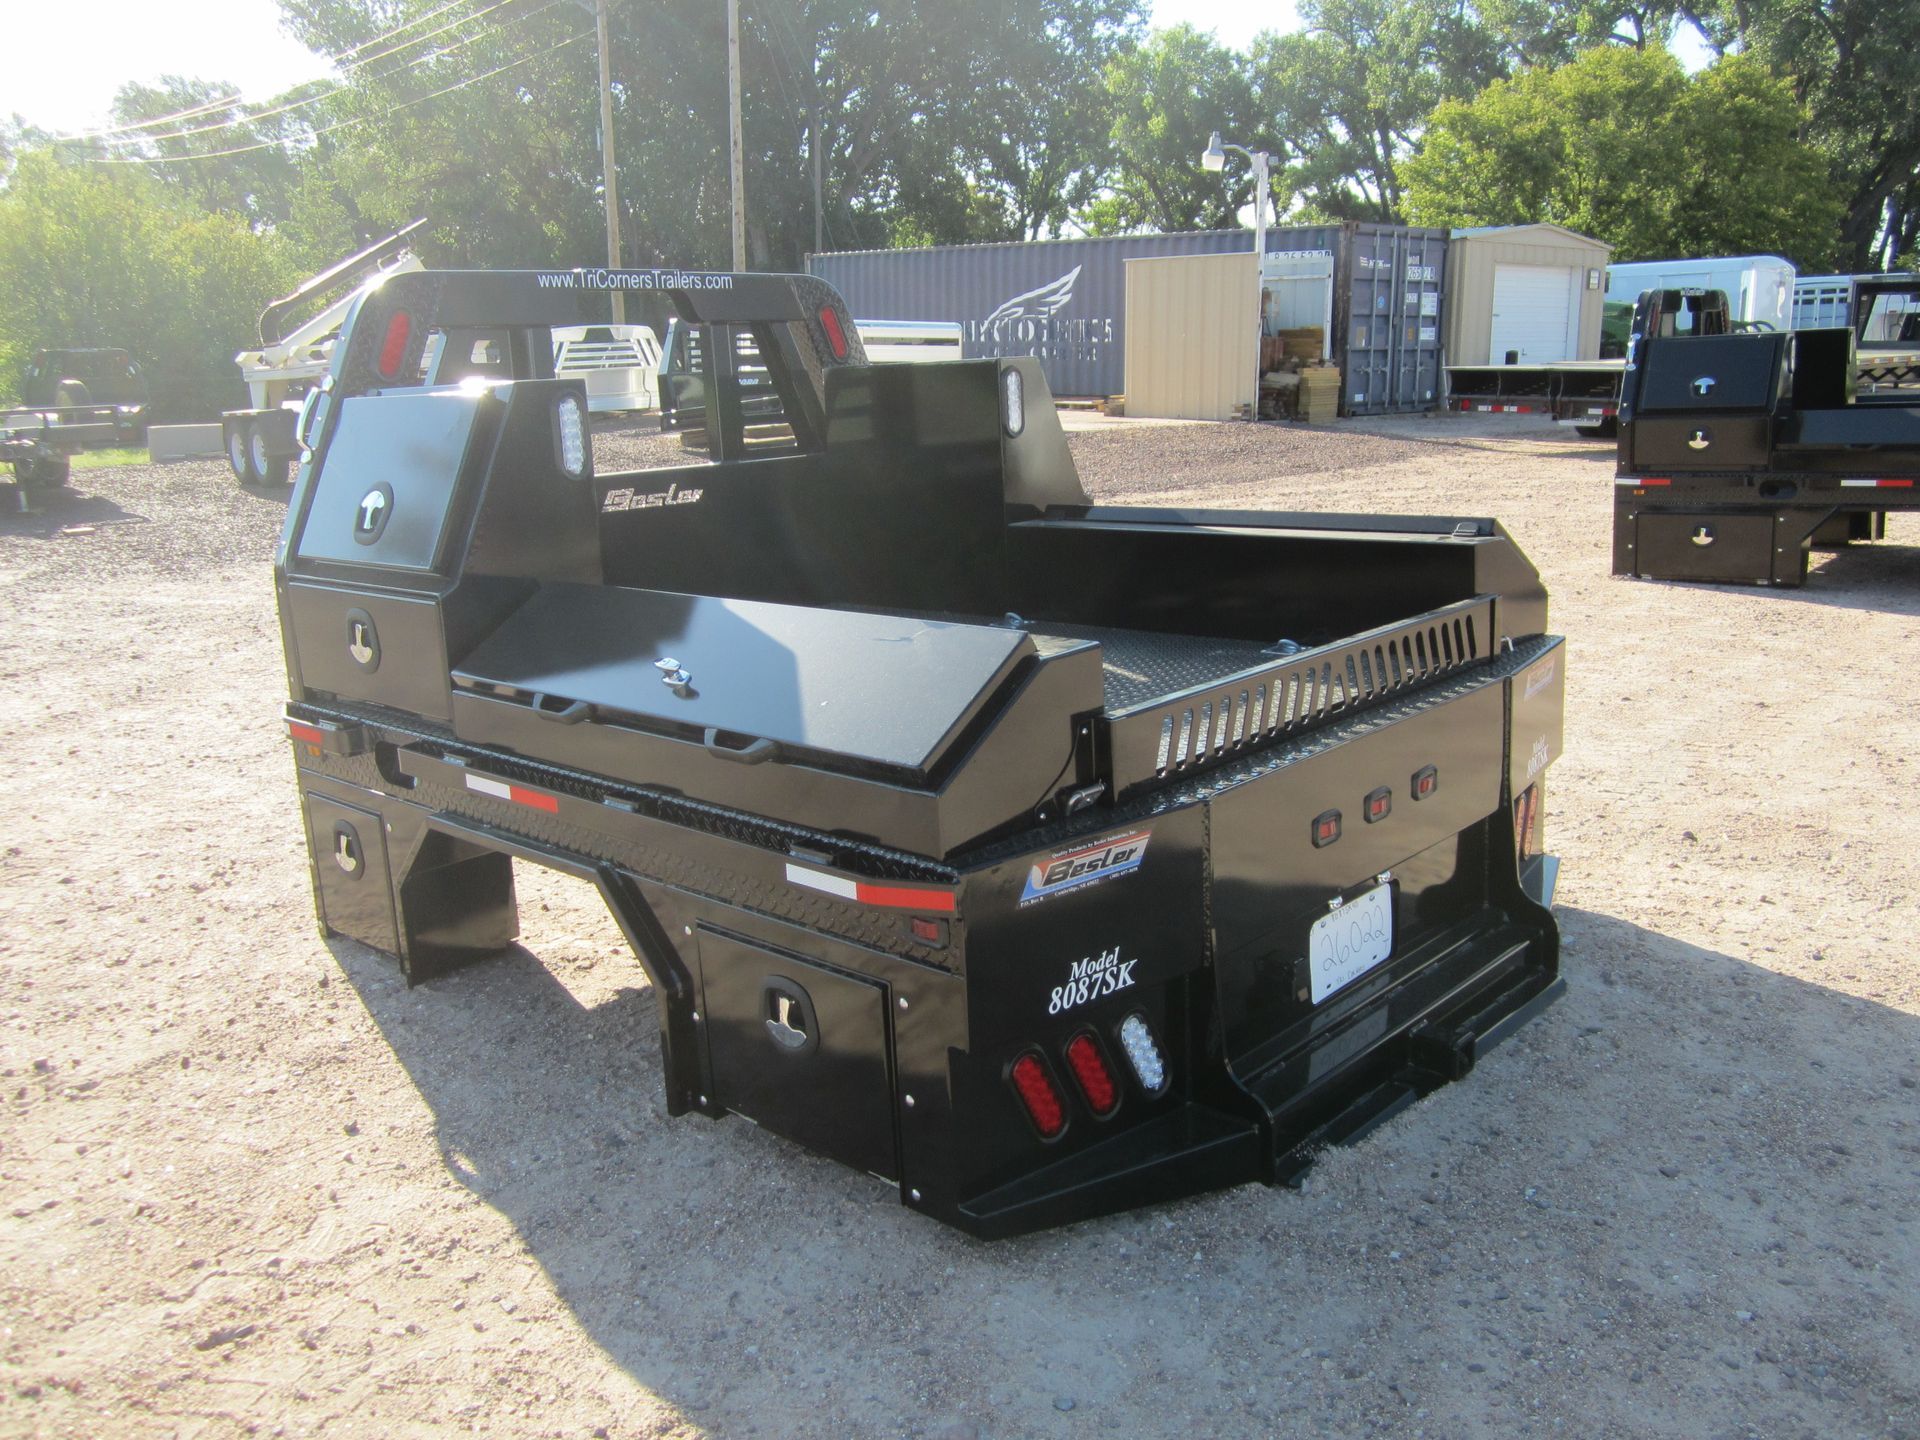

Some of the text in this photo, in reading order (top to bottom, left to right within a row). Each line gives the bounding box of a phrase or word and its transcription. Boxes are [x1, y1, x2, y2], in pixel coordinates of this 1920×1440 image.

[537, 269, 733, 290] www.TriCornersTrailers.com
[1042, 846, 1138, 887] Besler
[1320, 904, 1386, 972] 26022
[1069, 945, 1120, 982] Model
[1048, 958, 1138, 1015] 8087SK
